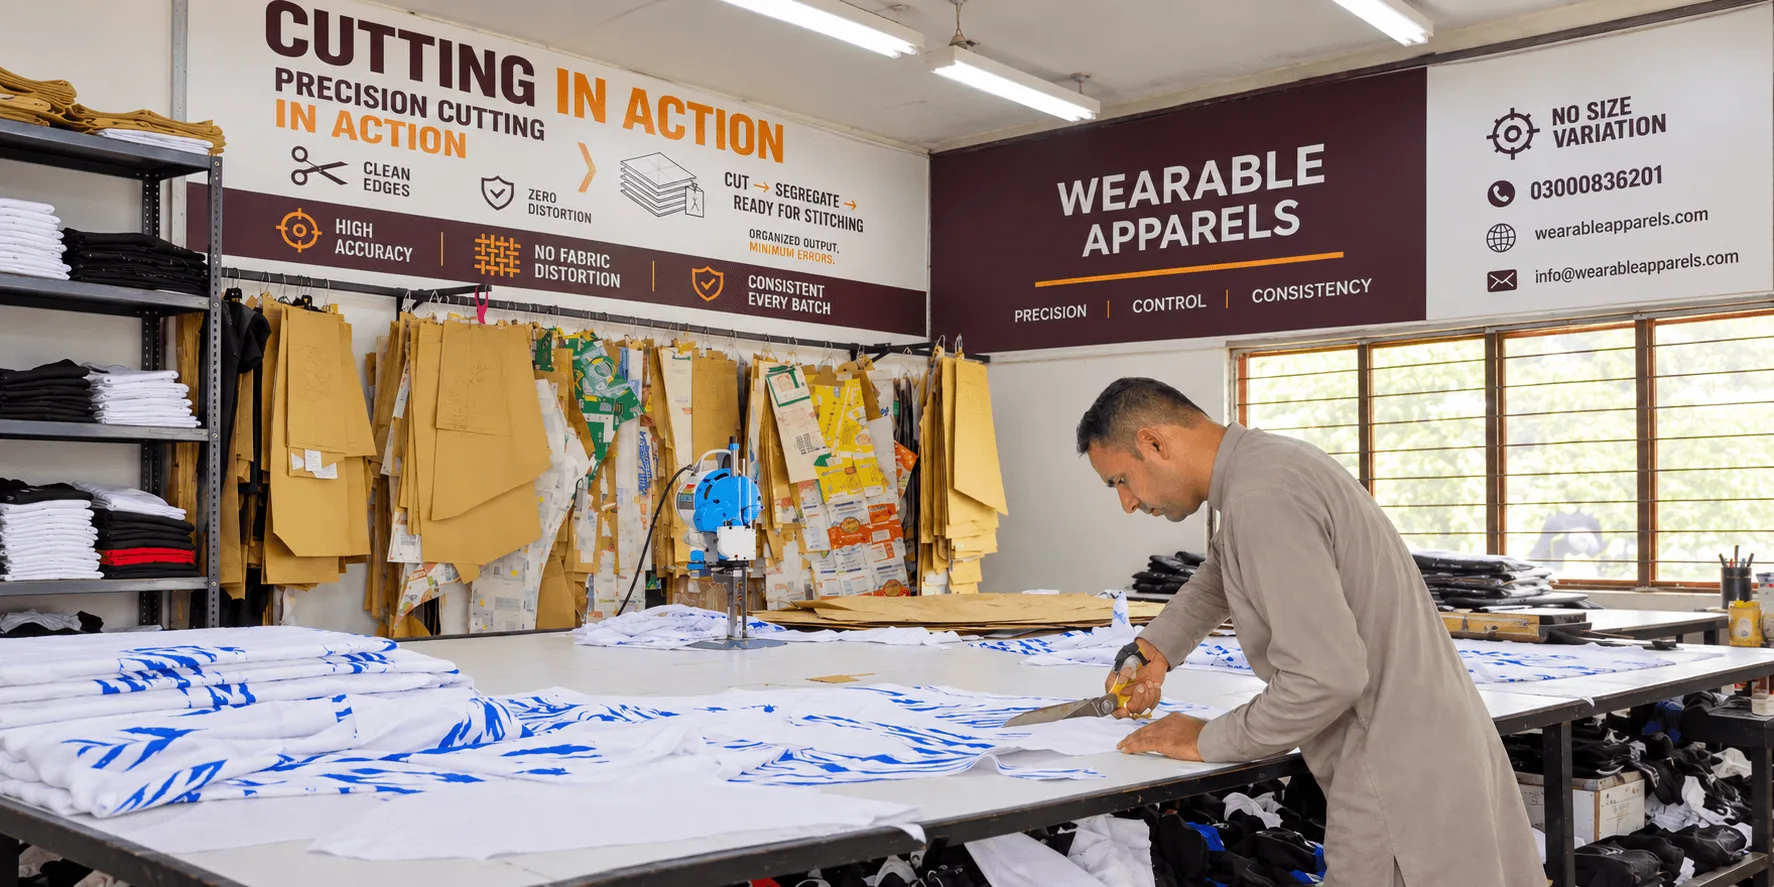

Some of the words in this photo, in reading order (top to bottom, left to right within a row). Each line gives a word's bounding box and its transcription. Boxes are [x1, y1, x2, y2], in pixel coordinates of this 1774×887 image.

[265, 0, 535, 107] CUTTING
[556, 66, 607, 125] IN
[622, 86, 784, 164] ACTION
[275, 66, 428, 119] PRECISION
[437, 98, 546, 141] CUTTING
[1552, 104, 1580, 126] NO
[1586, 95, 1632, 121] SIZE
[275, 98, 317, 134] IN
[331, 109, 467, 159] ACTION
[1553, 113, 1667, 149] VARIATION
[363, 160, 412, 182] CLEAN
[1056, 142, 1327, 218] WEARABLE
[1530, 164, 1663, 201] 03000836201
[363, 177, 411, 198] EDGES
[528, 188, 557, 204] ZERO
[724, 171, 750, 190] CUT
[775, 182, 840, 209] SEGREGATE
[335, 217, 374, 239] HIGH
[528, 202, 592, 224] DISTORTION
[733, 194, 774, 217] READY
[778, 203, 801, 222] FOR
[804, 210, 864, 233] STITCHING
[1081, 198, 1302, 258] APPARELS
[1534, 208, 1710, 241] wearableapparels.com
[335, 239, 414, 264] ACCURACY
[534, 244, 556, 262] NO
[559, 247, 611, 269] FABRIC
[749, 228, 801, 247] ORGANIZED
[803, 237, 840, 255] OUTPUT.
[749, 241, 795, 259] MINIMUM
[797, 247, 836, 266] ERRORS.
[534, 262, 622, 290] DISTORTION
[1534, 250, 1740, 284] info@wearableapparels.com
[747, 274, 826, 299] CONSISTENT
[1013, 303, 1088, 324] PRECISION
[1131, 293, 1208, 315] CONTROL
[1251, 277, 1373, 305] CONSISTENCY
[747, 292, 789, 312] EVERY
[791, 297, 832, 316] BATCH
